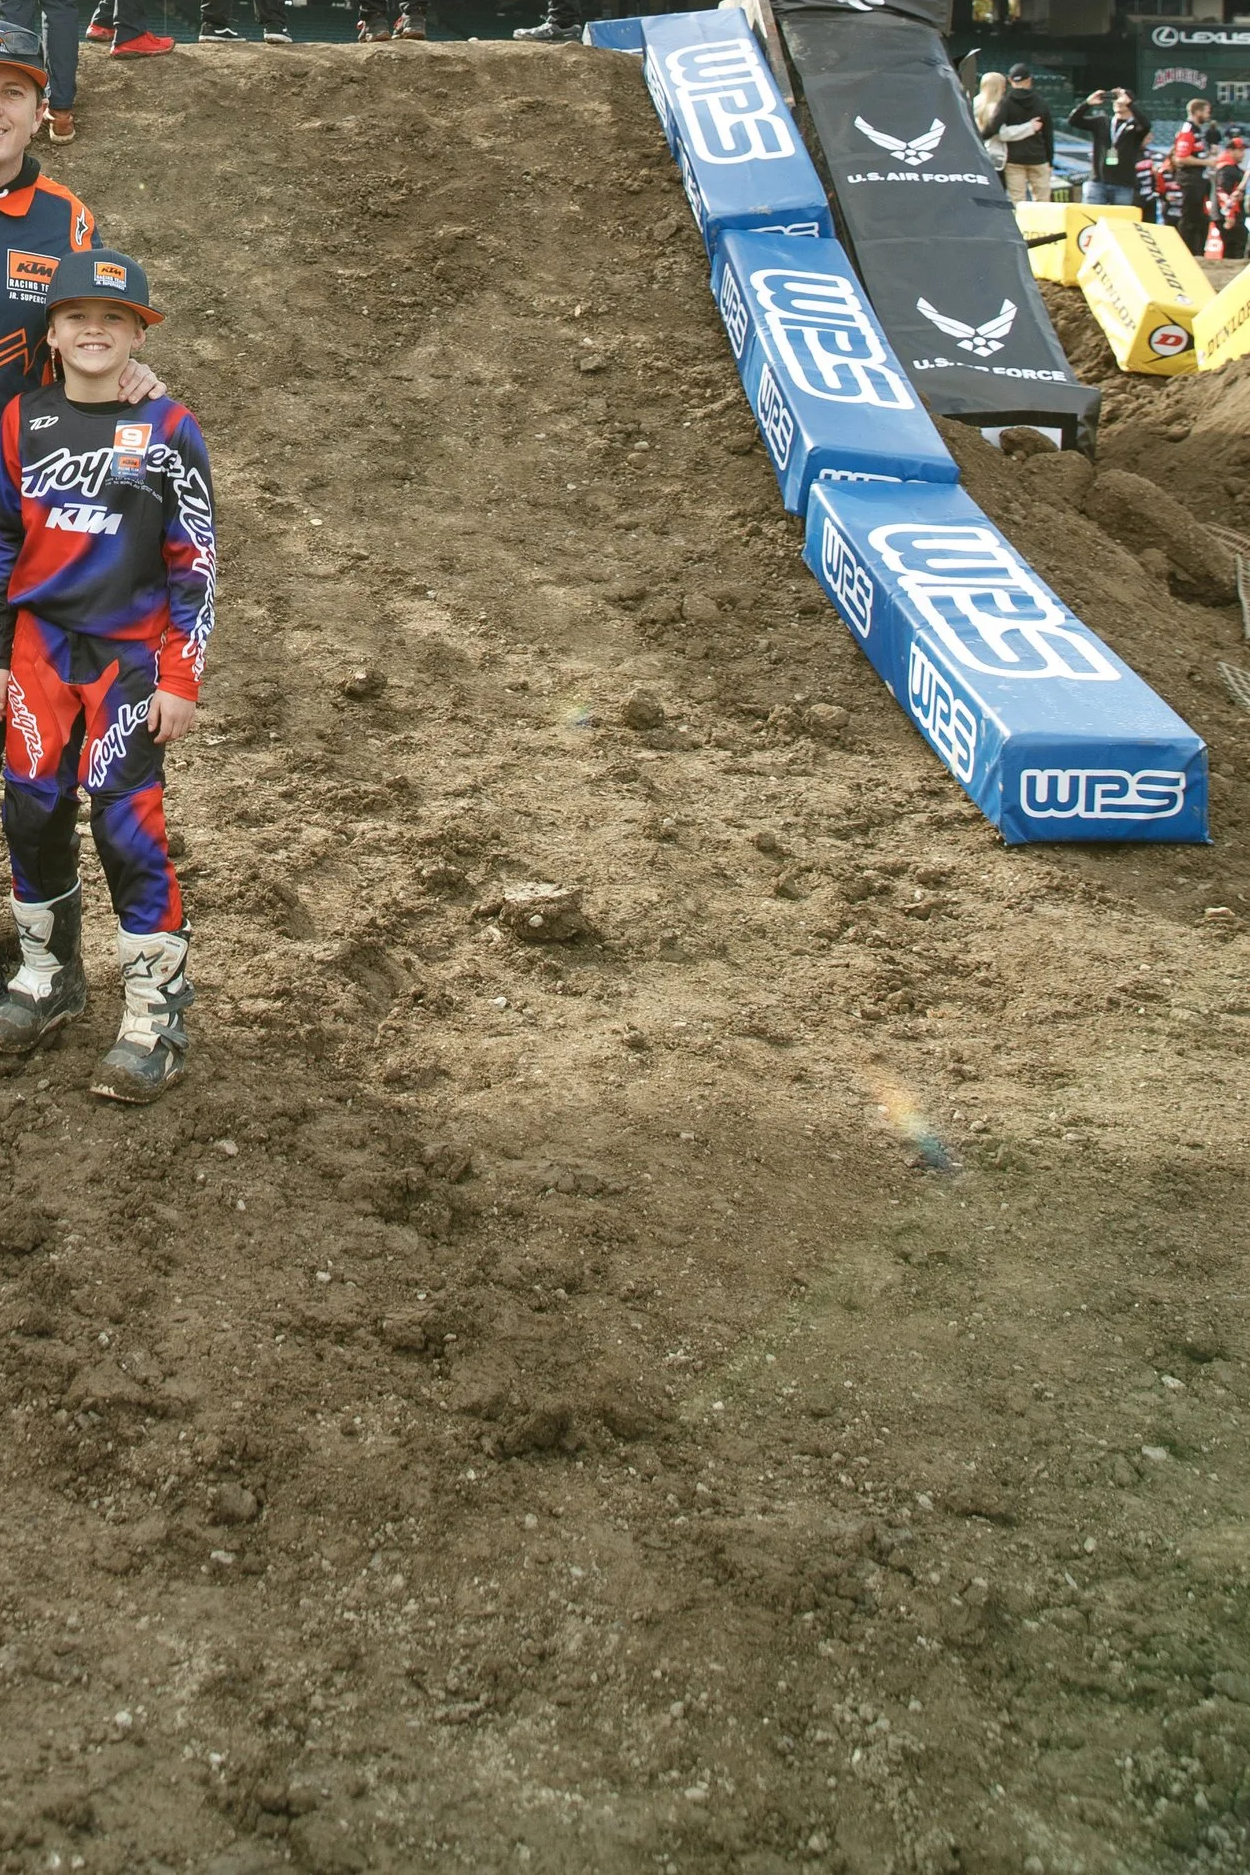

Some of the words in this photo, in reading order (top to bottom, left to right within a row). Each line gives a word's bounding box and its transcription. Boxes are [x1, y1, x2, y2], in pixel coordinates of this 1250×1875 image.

[1179, 31, 1250, 45] LEXUS
[665, 39, 796, 165] WPS
[847, 172, 885, 184] U.S.
[886, 172, 921, 182] AIR
[921, 173, 990, 185] FORCE
[16, 260, 53, 278] KTM
[101, 267, 122, 276] KTM
[9, 278, 41, 291] RACING
[9, 292, 20, 301] JR.
[1092, 261, 1136, 331] DUNLOP
[750, 269, 916, 410] WPS
[913, 357, 955, 370] U.S.
[992, 367, 1068, 382] FORCE
[29, 415, 59, 431] TLD
[121, 428, 143, 446] 9
[21, 447, 116, 497] Troy
[45, 502, 123, 536] KTM
[822, 517, 874, 639] WPS
[868, 524, 1121, 681] WPS
[908, 641, 977, 783] WPS
[1020, 769, 1186, 819] WPS
